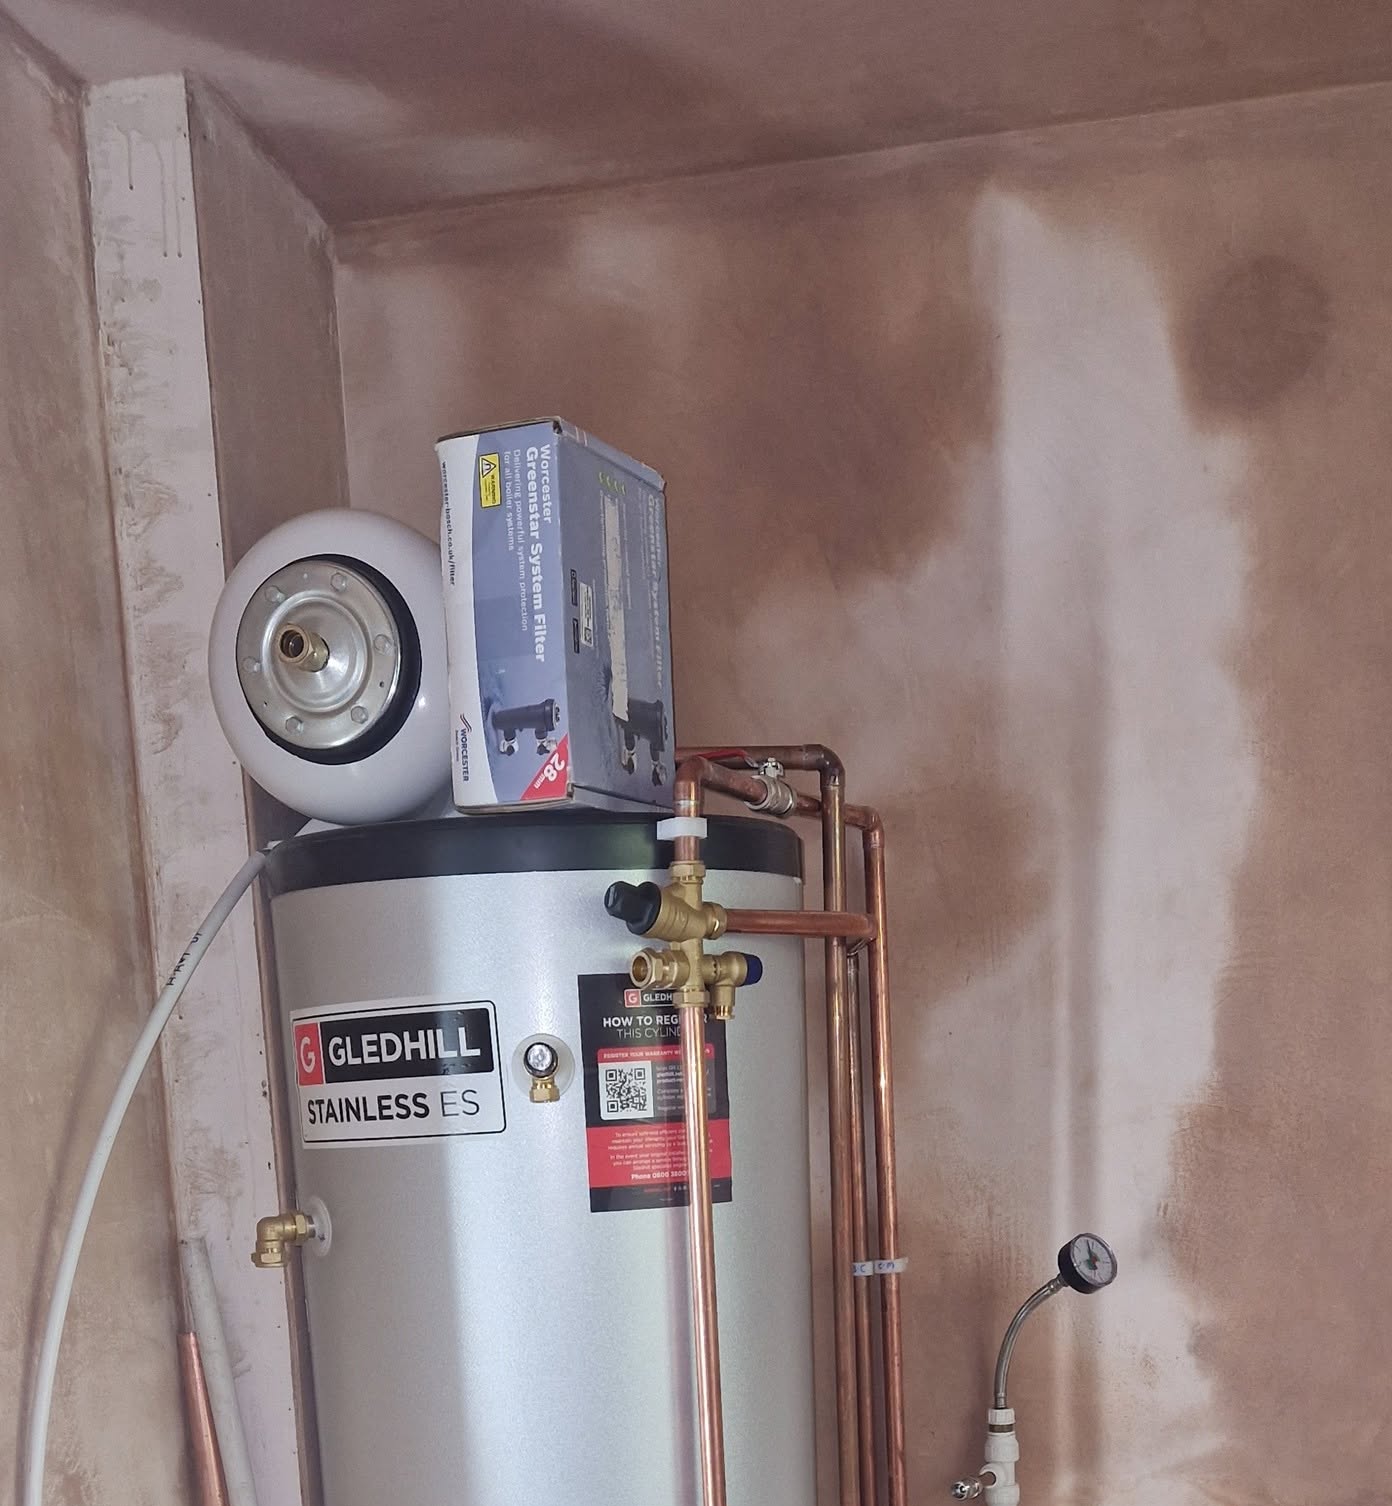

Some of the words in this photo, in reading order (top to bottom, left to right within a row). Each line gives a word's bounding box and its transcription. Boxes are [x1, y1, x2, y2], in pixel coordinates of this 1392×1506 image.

[505, 482, 513, 509] boiler
[512, 450, 521, 498] Delivering
[525, 447, 541, 539] Greenstar
[540, 444, 552, 524] Worcester
[506, 513, 515, 551] systems
[514, 501, 525, 543] powerful
[517, 547, 525, 579] system
[528, 543, 543, 610] System
[519, 582, 528, 631] protection
[534, 615, 547, 663] Filter
[460, 729, 470, 782] WORCESTER
[628, 994, 638, 1003] G
[643, 992, 673, 1002] GLEDH
[603, 1016, 633, 1027] HOW
[636, 1016, 653, 1026] TO
[617, 1028, 642, 1039] THIS
[299, 1036, 316, 1074] G
[328, 1026, 480, 1066] GLEDHILL
[308, 1092, 430, 1125] STAINLESS
[440, 1089, 480, 1118] ES
